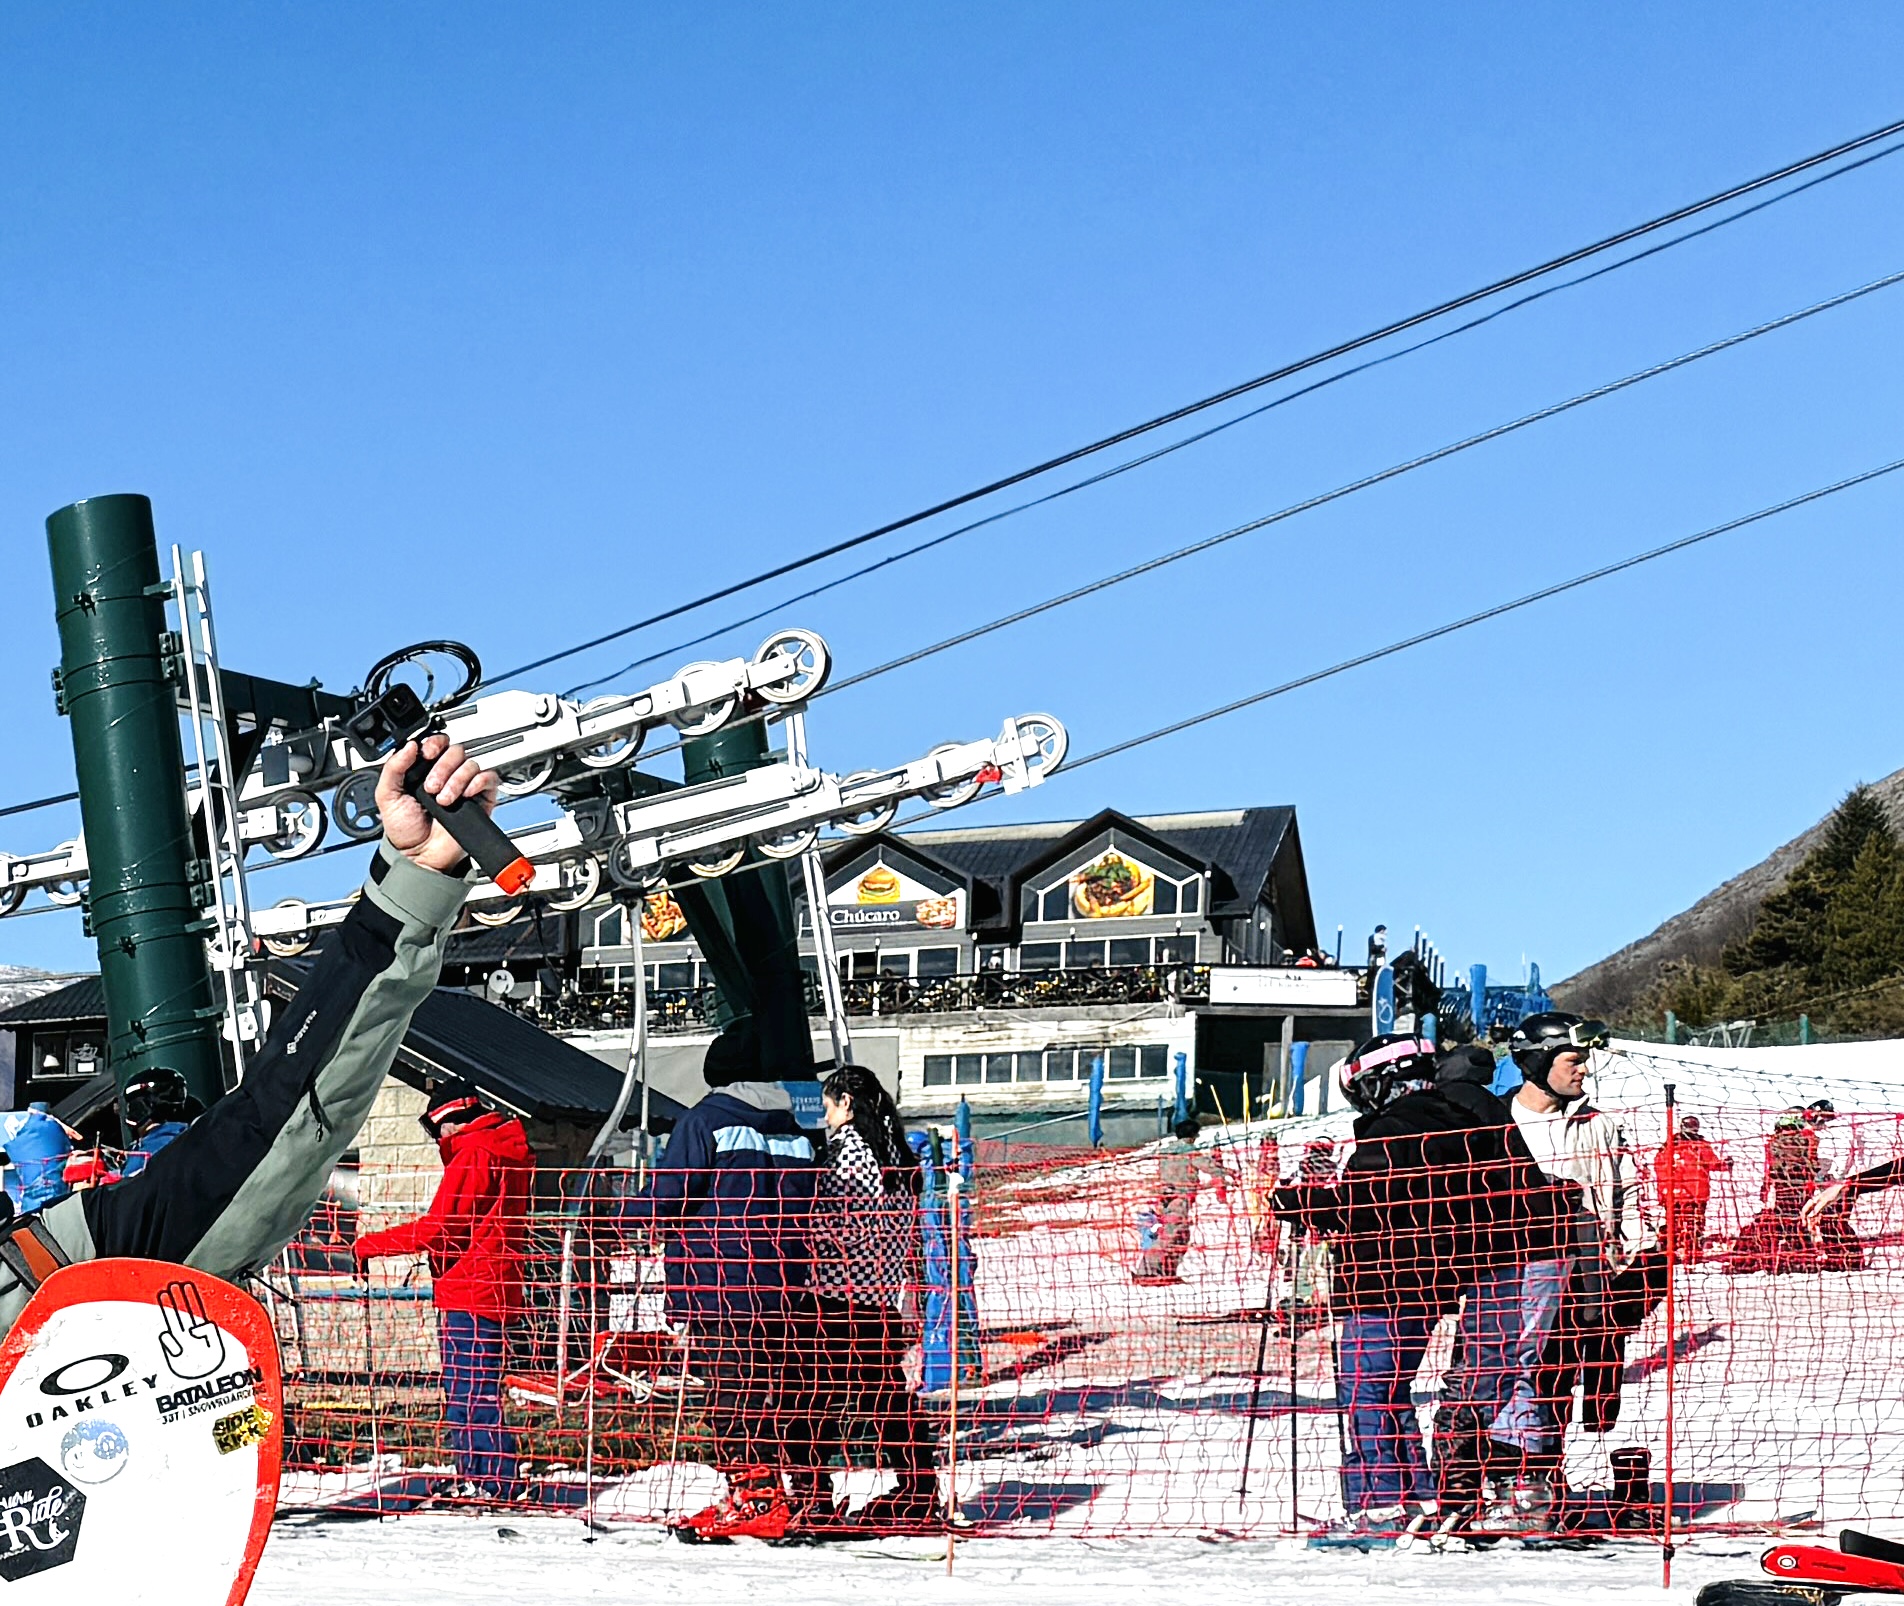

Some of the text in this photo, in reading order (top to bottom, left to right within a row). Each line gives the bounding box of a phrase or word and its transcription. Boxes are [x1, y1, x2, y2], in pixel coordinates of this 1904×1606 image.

[830, 908, 901, 924] Chúcaro
[25, 1373, 158, 1429] OAKLEY
[155, 1366, 263, 1414] BATALEON
